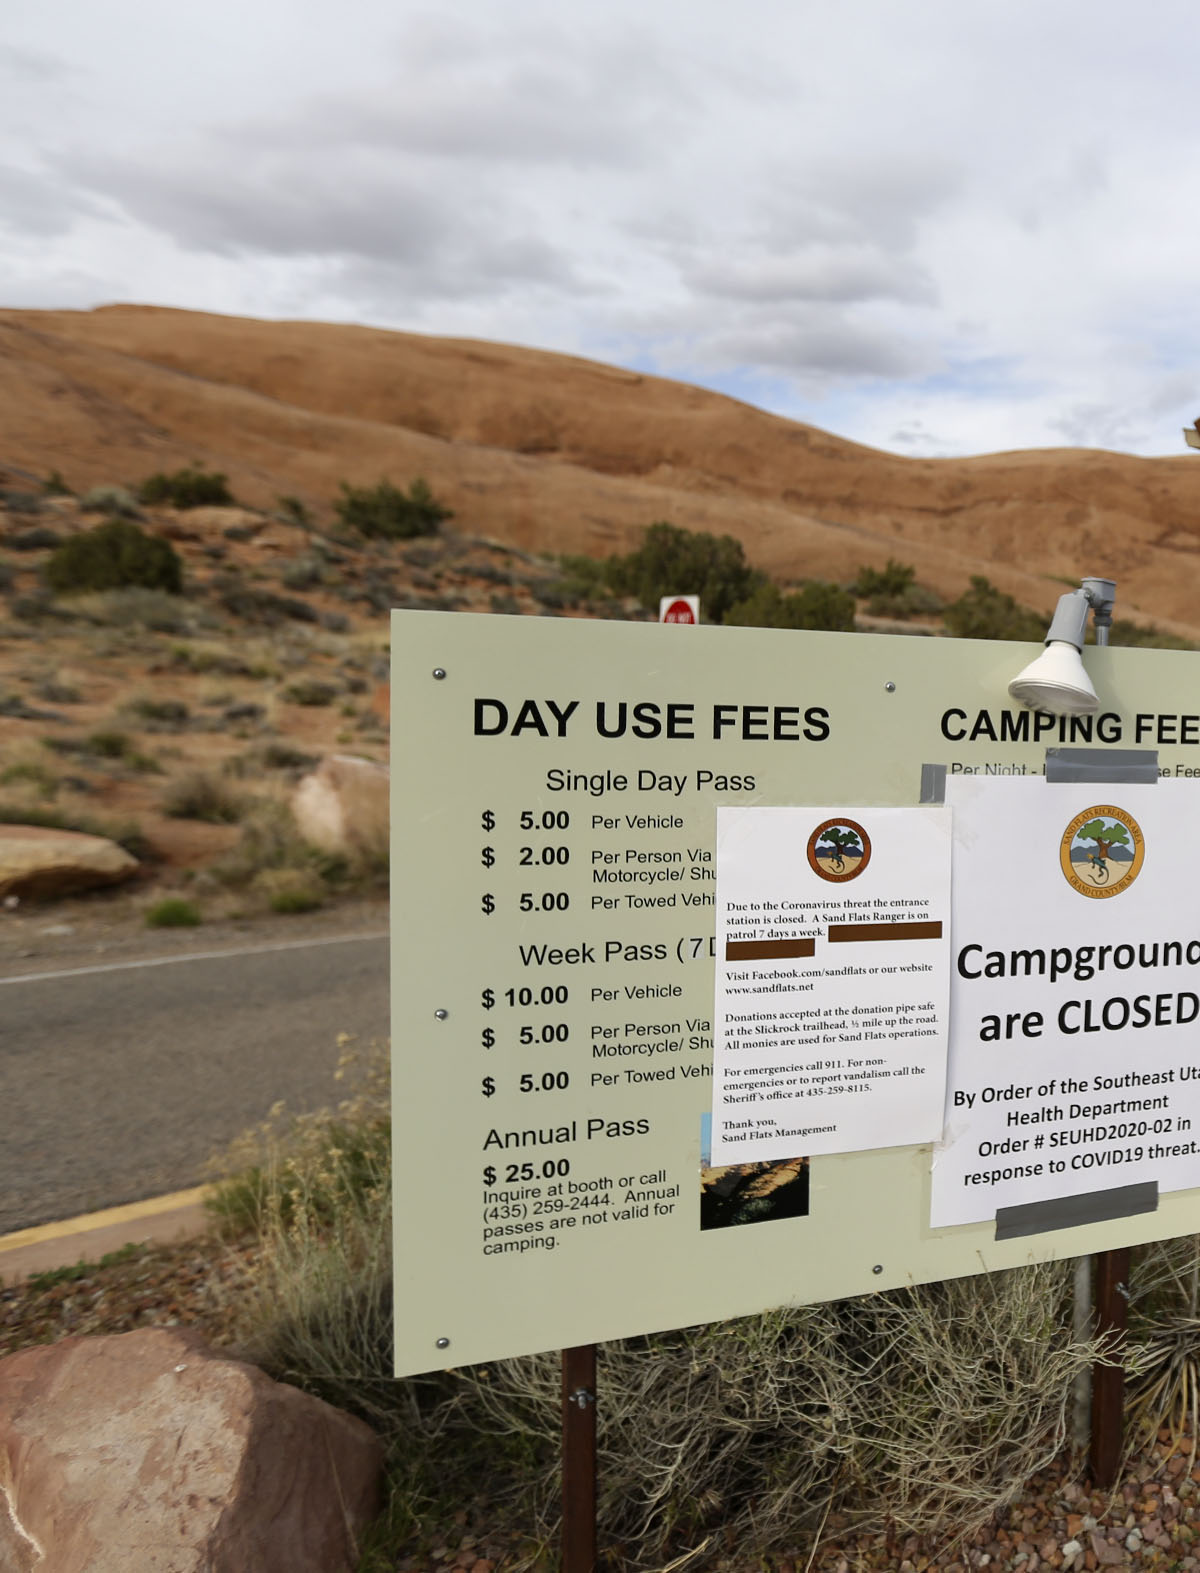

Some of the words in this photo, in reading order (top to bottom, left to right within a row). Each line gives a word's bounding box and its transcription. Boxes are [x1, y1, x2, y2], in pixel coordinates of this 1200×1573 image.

[474, 698, 580, 736] DAY
[596, 702, 694, 739] USE
[712, 705, 829, 741] FEES
[940, 708, 1122, 742] CAMPING
[546, 769, 627, 796] Single
[638, 770, 687, 796] Day
[696, 770, 755, 791] Pass
[519, 810, 569, 829] 5.00
[592, 815, 620, 829] Per
[625, 815, 683, 828] Vehicle
[519, 846, 569, 865] 2.00
[591, 850, 620, 864] Per
[625, 850, 681, 863] Person
[686, 848, 711, 862] Via
[592, 867, 684, 884] Motorcycle/
[519, 892, 569, 911] 5.00
[591, 896, 620, 909] Per
[624, 894, 676, 908] Towed
[727, 902, 747, 911] Due
[762, 901, 778, 910] the
[780, 901, 840, 909] Coronavirus
[843, 899, 870, 908] threat
[873, 898, 888, 907] the
[726, 916, 760, 925] station
[763, 915, 771, 924] is
[773, 914, 806, 924] closed.
[822, 913, 845, 922] Sand
[848, 912, 870, 921] Flats
[872, 912, 905, 922] Ranger
[907, 911, 914, 919] is
[726, 928, 757, 941] patrol
[767, 929, 789, 940] days
[799, 927, 826, 937] week.
[518, 943, 595, 965] Week
[605, 941, 666, 961] Pass
[726, 972, 748, 980] Visit
[752, 966, 866, 979] Facebook.com/sandflats
[899, 963, 932, 972] website
[504, 985, 568, 1006] 10.00
[591, 988, 619, 1001] Per
[624, 984, 682, 999] Vehicle
[725, 983, 813, 994] www.sandflats.net
[725, 1012, 777, 1022] Donations
[778, 1008, 820, 1020] accepted
[834, 1007, 849, 1015] the
[851, 1005, 893, 1014] donation
[895, 1004, 915, 1014] pipe
[917, 1001, 934, 1010] safe
[979, 1012, 1043, 1041] are
[1057, 992, 1199, 1034] CLOSED
[519, 1023, 568, 1044] 5.00
[591, 1026, 620, 1039] Per
[624, 1023, 680, 1036] Person
[685, 1019, 710, 1032] Via
[724, 1028, 734, 1036] at
[736, 1026, 752, 1035] the
[754, 1023, 800, 1034] Slickrock
[802, 1020, 848, 1031] trailhead,
[862, 1018, 882, 1027] mile
[884, 1019, 896, 1027] up
[898, 1016, 913, 1024] the
[915, 1014, 938, 1023] road.
[592, 1039, 684, 1057] Motorcycle/
[724, 1040, 739, 1050] All
[742, 1039, 778, 1048] monies
[798, 1035, 819, 1044] used
[822, 1034, 836, 1043] for
[838, 1032, 861, 1042] Sand
[864, 1031, 886, 1040] Flats
[888, 1028, 938, 1040] operations.
[723, 1079, 784, 1091] emergencies
[811, 1074, 840, 1085] report
[843, 1070, 890, 1080] vandalism
[892, 1066, 908, 1076] call
[910, 1066, 925, 1074] the
[724, 1068, 741, 1077] For
[743, 1063, 804, 1076] emergencies
[805, 1060, 824, 1070] call
[824, 1060, 845, 1069] 911.
[847, 1059, 863, 1067] For
[519, 1071, 568, 1092] 5.00
[591, 1073, 619, 1086] Per
[623, 1067, 674, 1083] Towed
[954, 1090, 976, 1107] By
[981, 1085, 1032, 1103] Order
[1037, 1080, 1056, 1096] of
[1060, 1078, 1088, 1094] the
[1092, 1070, 1174, 1090] Southeast
[766, 1090, 794, 1101] office
[806, 1083, 873, 1097] 435-259-8115.
[1007, 1106, 1063, 1126] Health
[1069, 1096, 1168, 1119] Department
[482, 1121, 576, 1150] Annual
[587, 1118, 649, 1139] Pass
[722, 1119, 753, 1129] Thank
[756, 1119, 776, 1129] you,
[722, 1132, 746, 1142] Sand
[749, 1131, 772, 1140] Flats
[774, 1125, 836, 1137] Management
[978, 1138, 1029, 1156] Order
[1049, 1119, 1172, 1147] SEUHD2020-02
[1177, 1117, 1190, 1131] in
[505, 1159, 570, 1182] 25.00
[964, 1164, 1043, 1185] response
[1048, 1160, 1065, 1173] to
[1070, 1147, 1143, 1169] COVID19
[1147, 1141, 1200, 1158] threat.
[483, 1187, 541, 1204] Inquire
[546, 1183, 563, 1196] at
[568, 1177, 612, 1194] booth
[618, 1176, 634, 1188] or
[639, 1169, 665, 1184] call
[483, 1203, 527, 1224] (435)
[532, 1193, 614, 1214] 259-2444.
[624, 1184, 679, 1204] Annual
[483, 1221, 544, 1241] passes
[549, 1217, 576, 1229] are
[582, 1210, 607, 1225] not
[611, 1204, 648, 1220] valid
[653, 1202, 674, 1215] for
[482, 1236, 559, 1255] camping.
